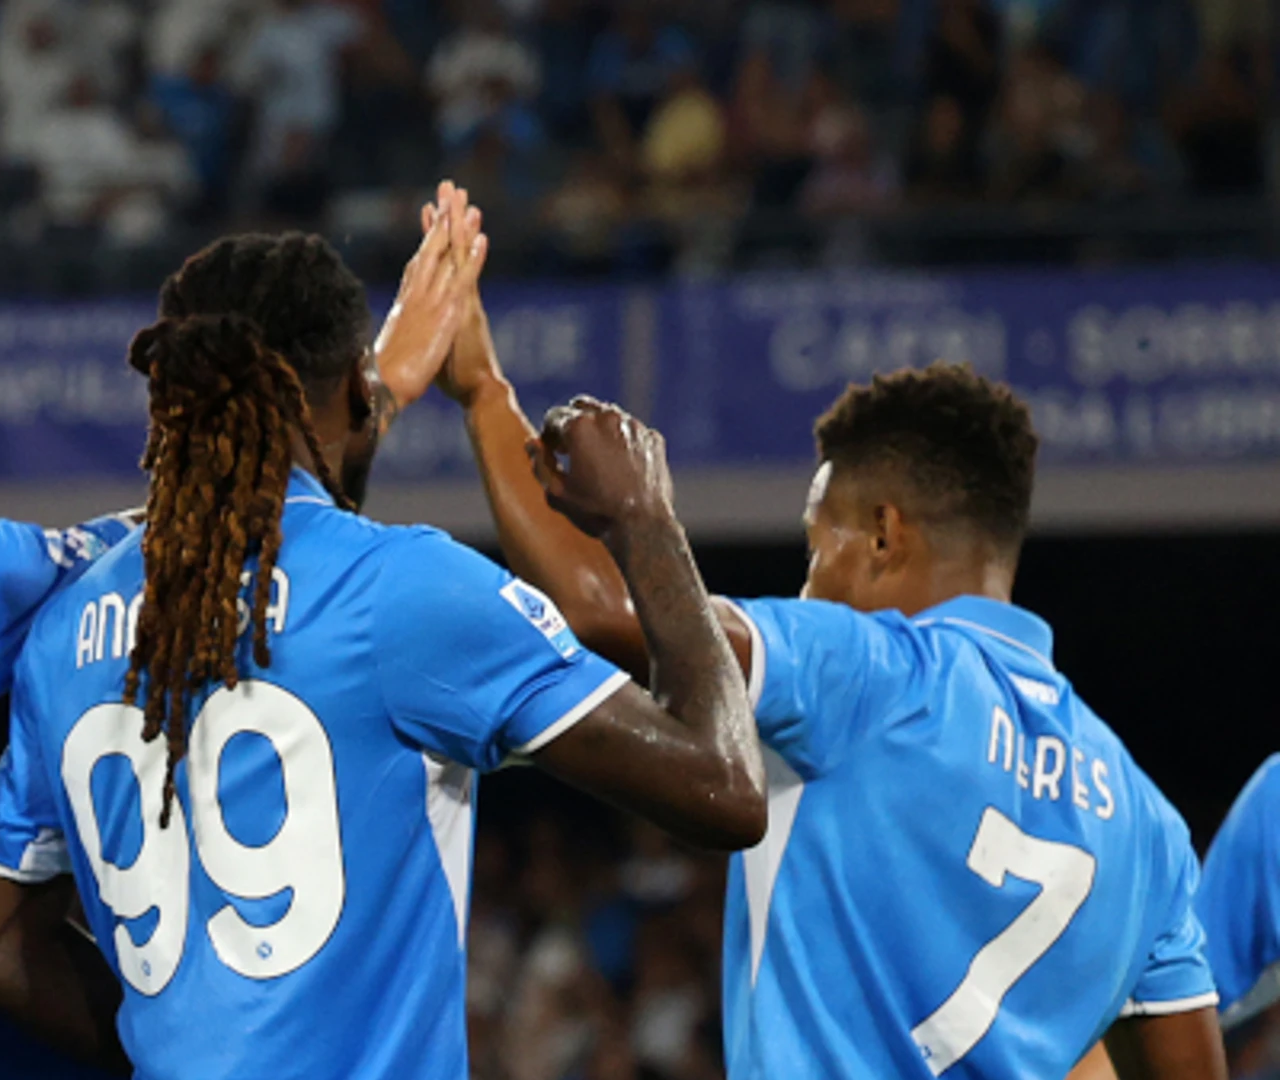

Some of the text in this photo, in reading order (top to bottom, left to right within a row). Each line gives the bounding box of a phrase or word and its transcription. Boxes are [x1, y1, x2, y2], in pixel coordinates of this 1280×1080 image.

[61, 679, 346, 996] 99
[987, 705, 1114, 819] NERES
[911, 805, 1096, 1077] 7
